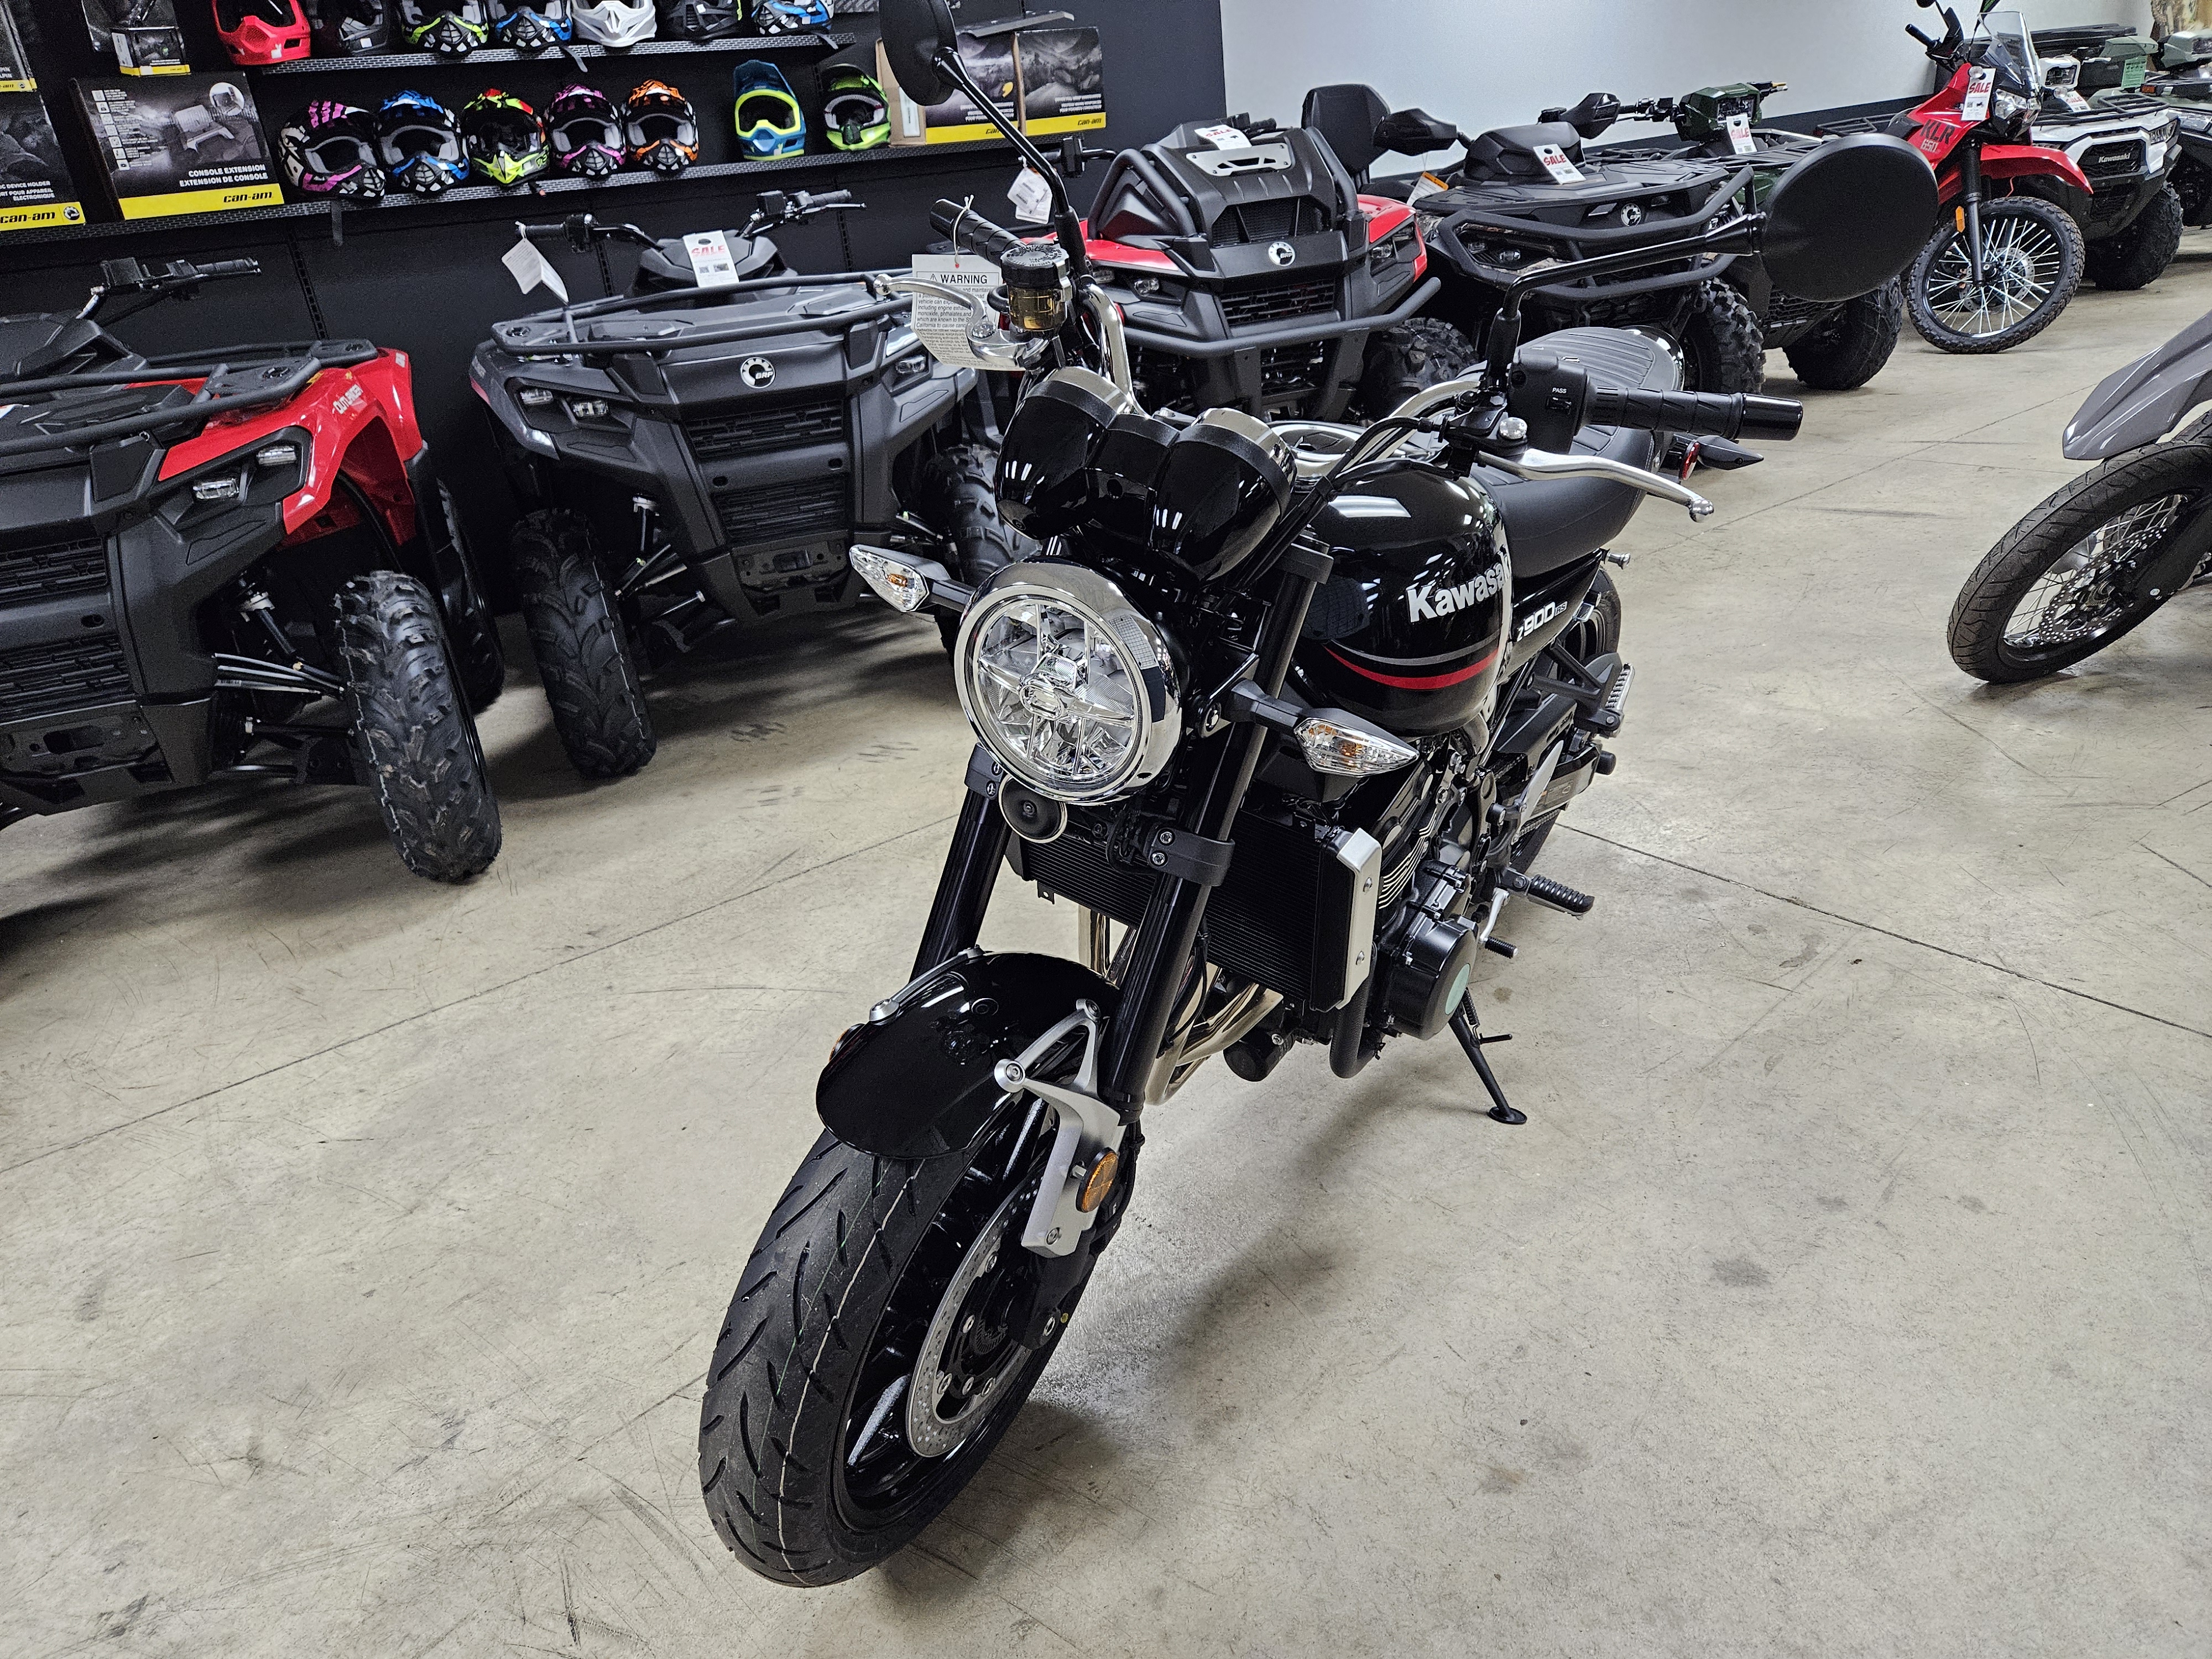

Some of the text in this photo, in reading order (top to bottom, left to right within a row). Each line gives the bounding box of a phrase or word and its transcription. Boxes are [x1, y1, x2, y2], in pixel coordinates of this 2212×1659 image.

[1968, 82, 1991, 94] SALE
[1206, 128, 1233, 137] SALE
[1920, 119, 1956, 145] KLR
[1921, 139, 1939, 154] 650
[1543, 155, 1567, 166] SALE
[2098, 152, 2131, 163] Kawasaki
[188, 164, 266, 178] CONSOLE EXTENSION
[179, 176, 222, 187] EXTENSION
[234, 172, 268, 182] CONSOLE
[223, 191, 273, 203] can-am
[0, 212, 55, 223] can-am
[691, 246, 726, 258] SALE
[941, 274, 988, 284] WARNING
[755, 371, 774, 379] BRP
[1406, 551, 1511, 623] Kawasak
